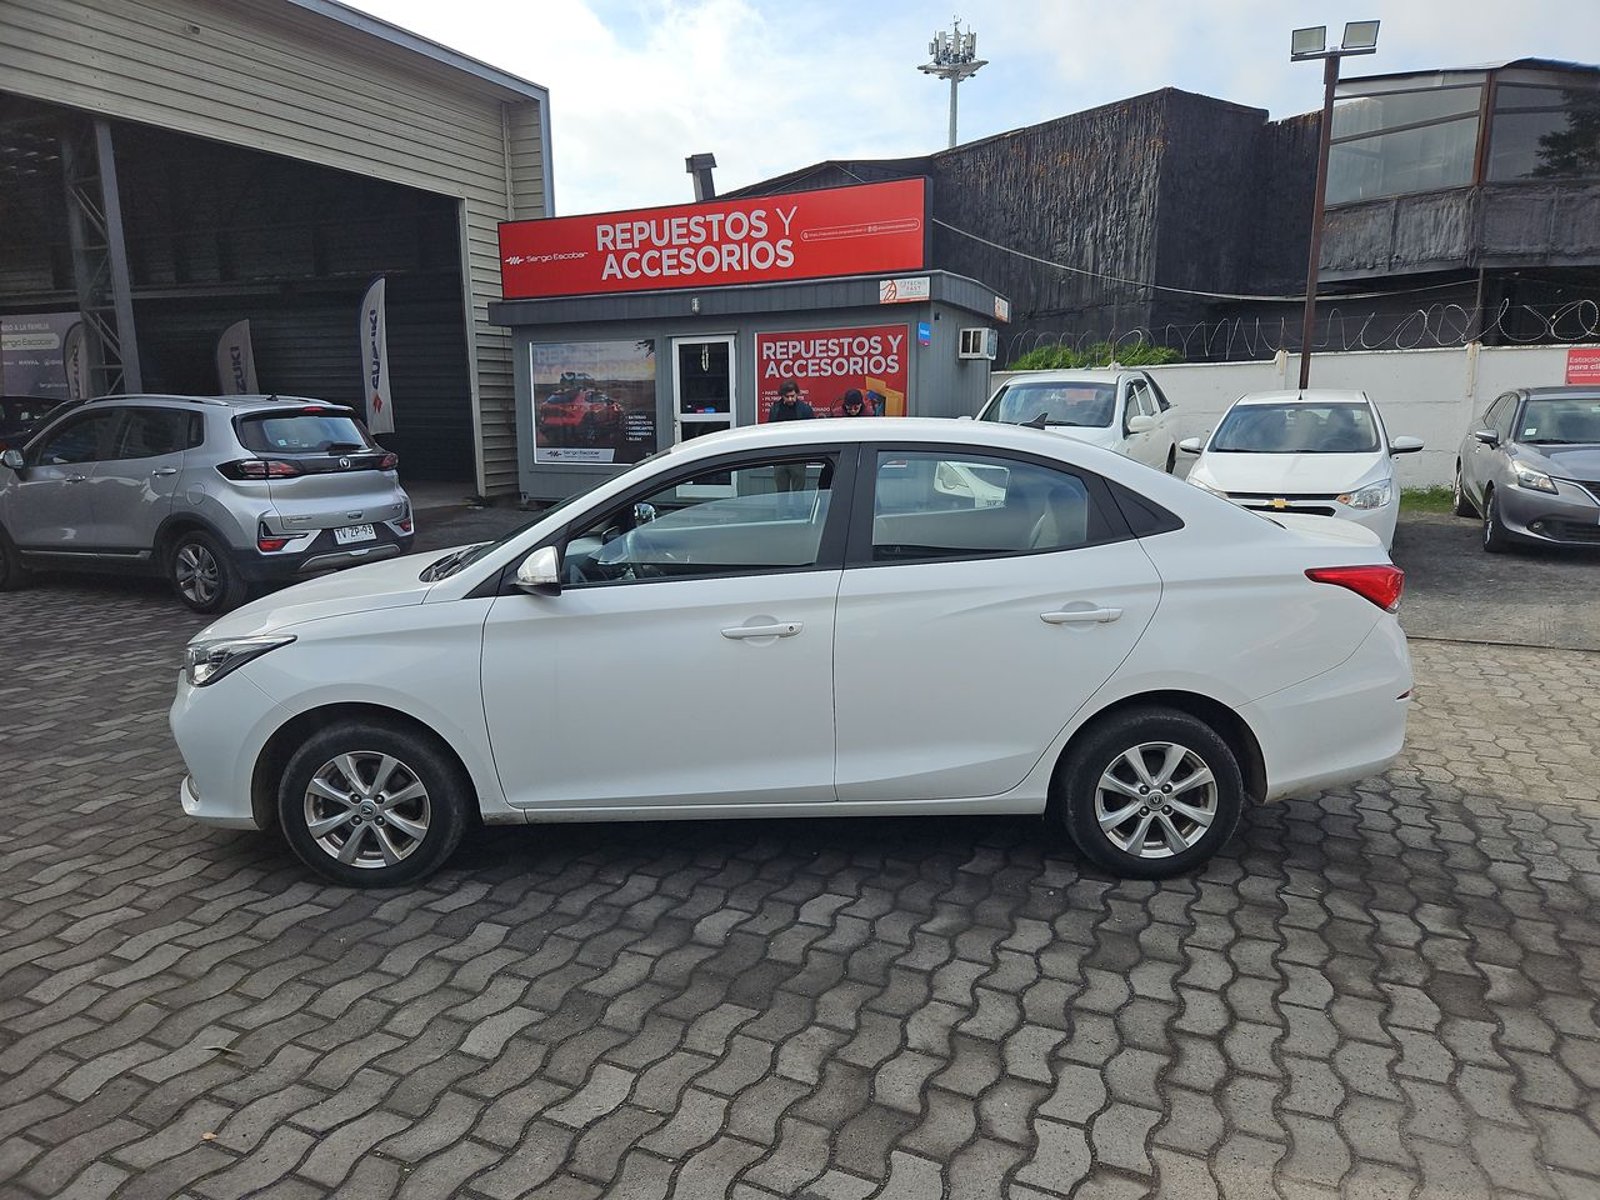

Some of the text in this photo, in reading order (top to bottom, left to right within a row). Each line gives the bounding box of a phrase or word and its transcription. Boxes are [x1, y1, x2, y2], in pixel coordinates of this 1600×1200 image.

[596, 206, 798, 251] REPUESTOS Y
[601, 239, 795, 281] ACCESORIOS
[762, 334, 903, 360] REPUESTOS Y
[764, 354, 900, 379] ACCESORIOS
[336, 529, 347, 539] TV
